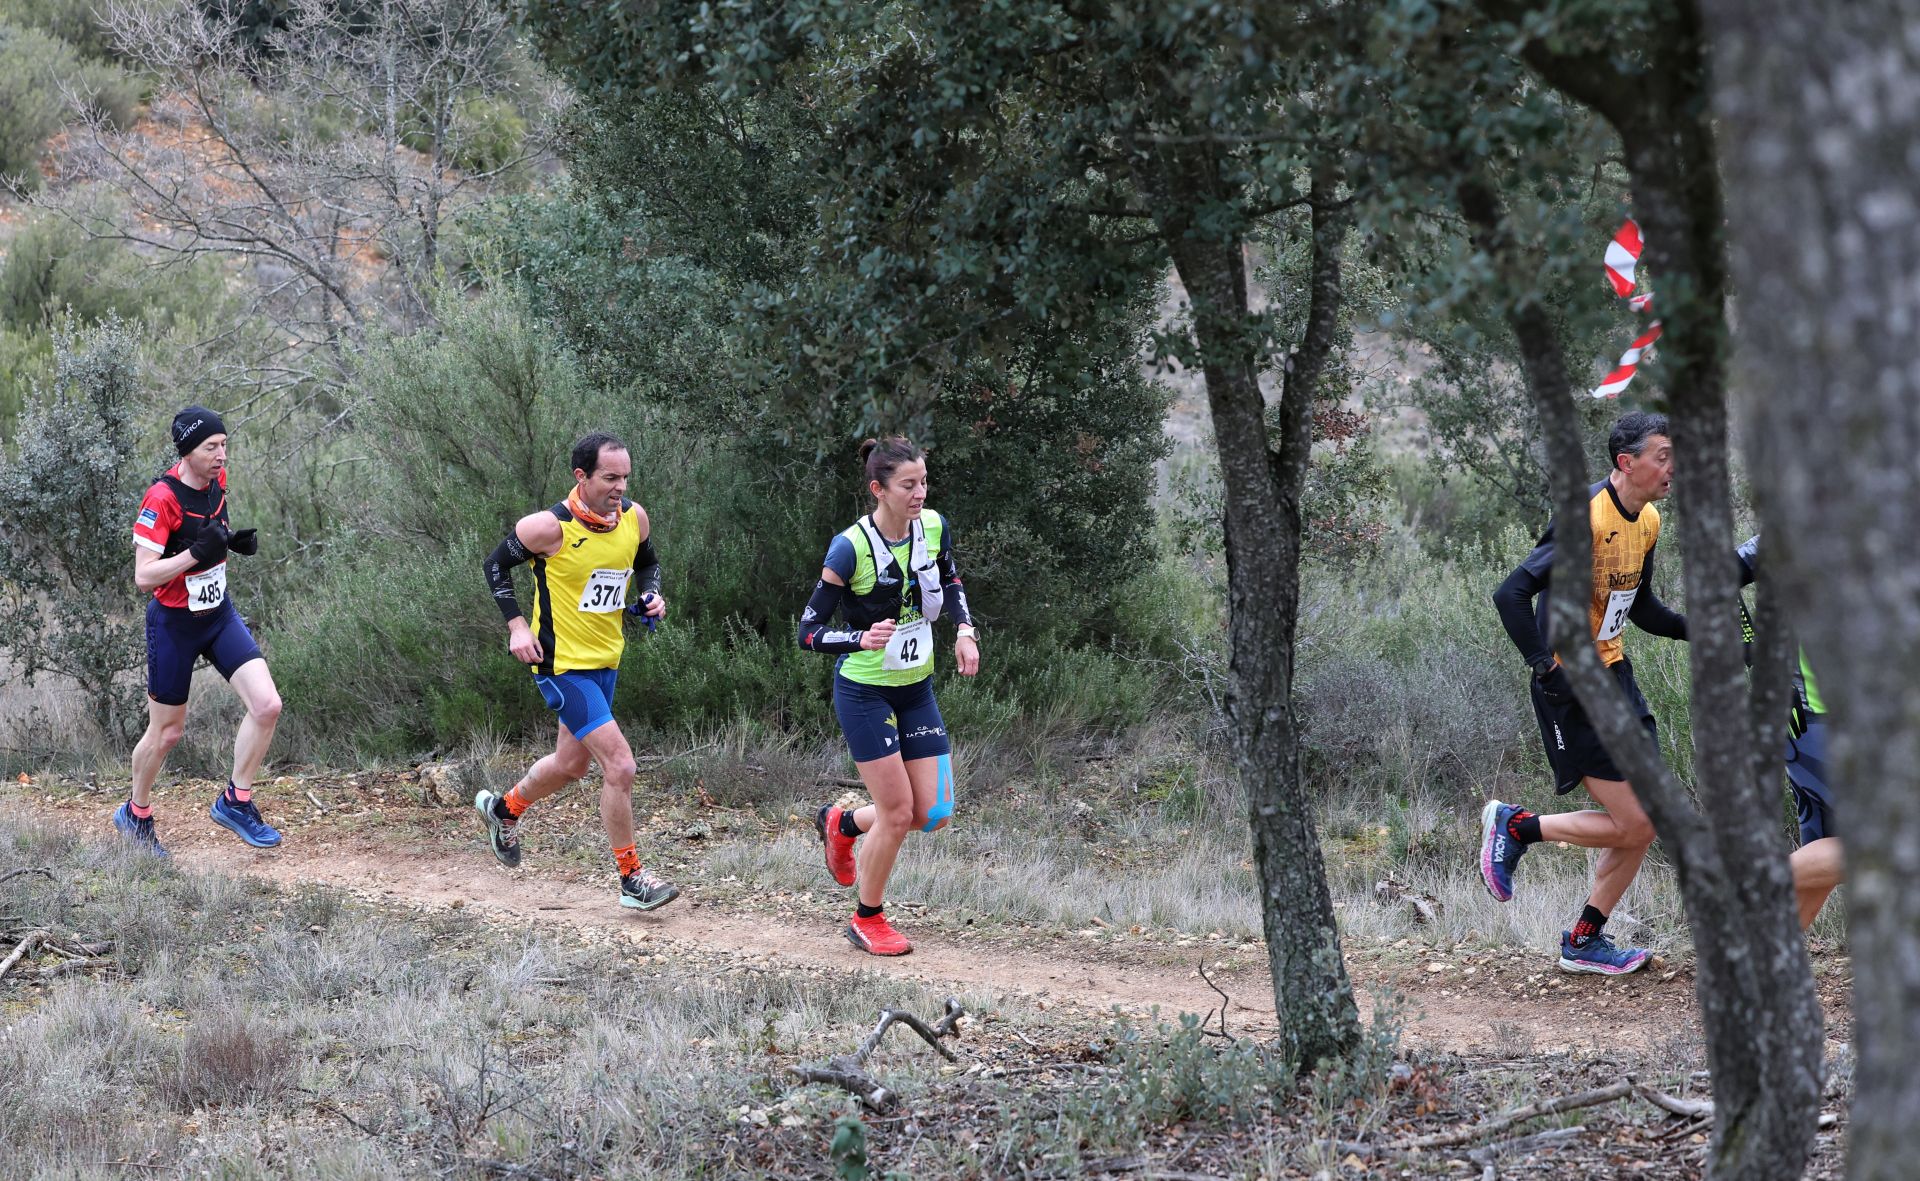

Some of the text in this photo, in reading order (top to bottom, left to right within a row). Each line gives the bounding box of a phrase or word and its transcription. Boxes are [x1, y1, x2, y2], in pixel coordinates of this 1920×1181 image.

[198, 580, 221, 604] 485
[591, 584, 621, 607] 370
[901, 637, 919, 663] 42
[1553, 720, 1566, 751] ERREX
[1494, 834, 1506, 863] HOKA
